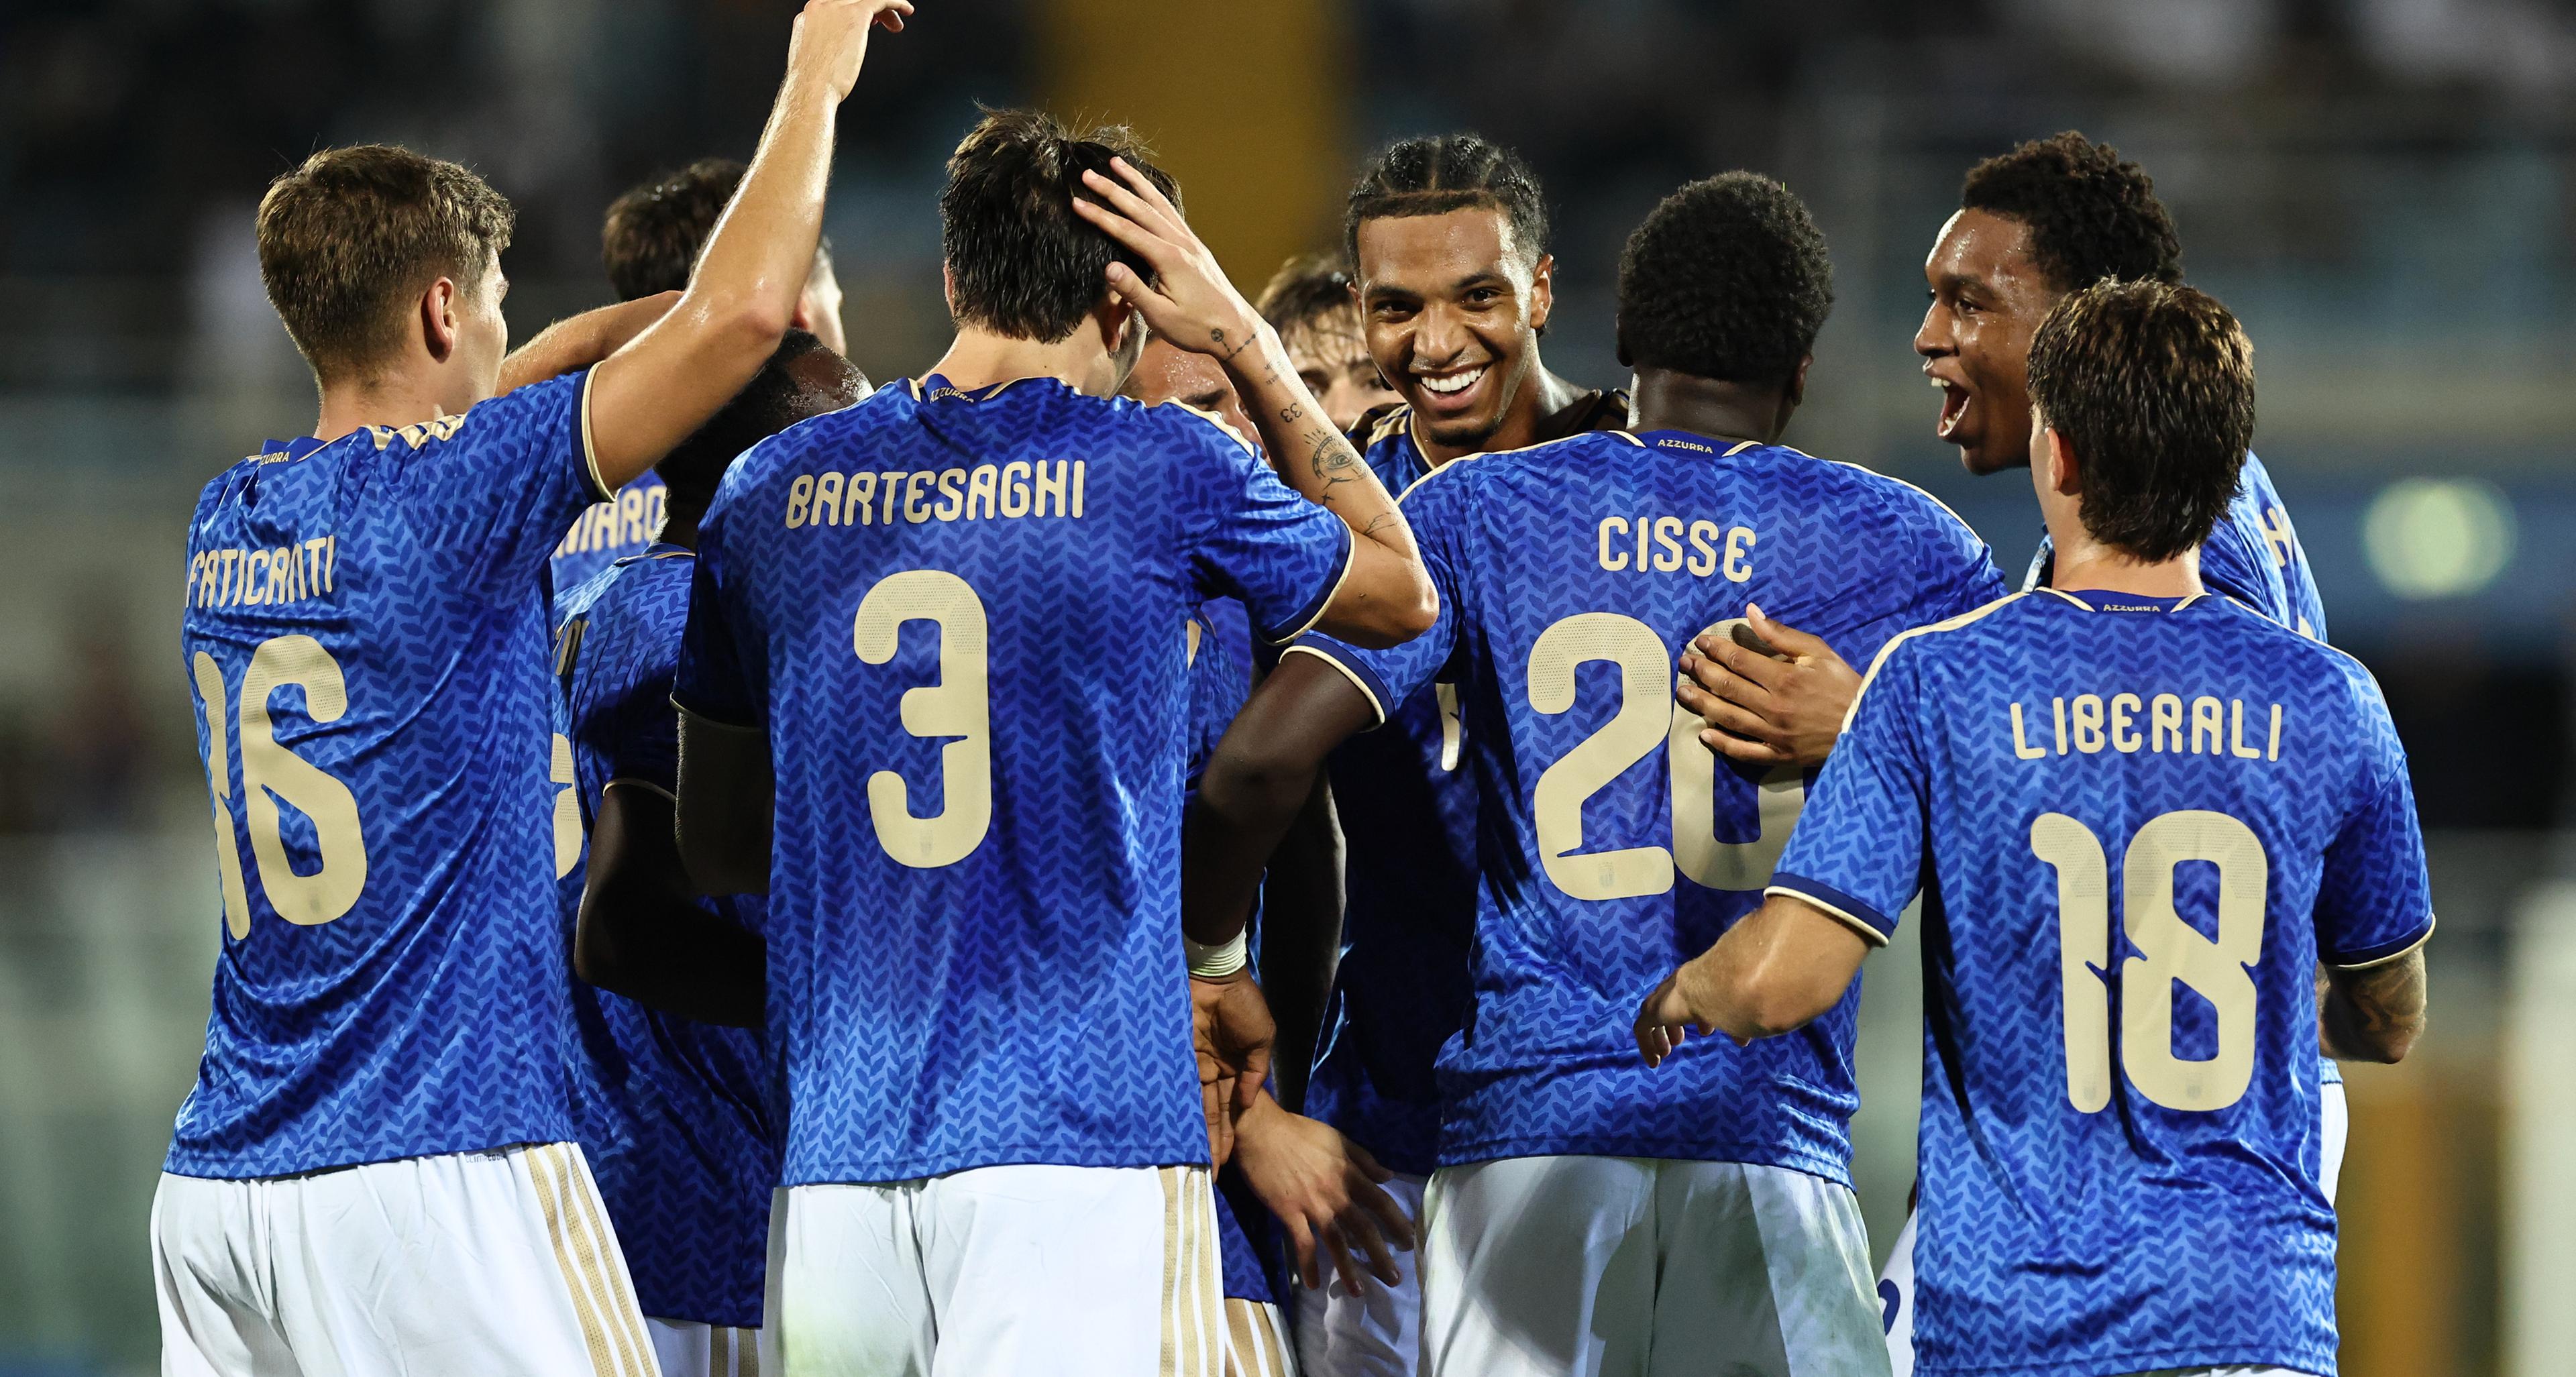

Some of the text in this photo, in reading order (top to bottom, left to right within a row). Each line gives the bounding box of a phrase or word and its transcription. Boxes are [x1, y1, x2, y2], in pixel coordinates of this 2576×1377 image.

[1658, 439, 1713, 453] AZZURRA
[786, 460, 1085, 529] BARTESAGHI
[186, 535, 335, 609] FATICANTI
[1598, 516, 1756, 582] CISSE
[2103, 604, 2161, 612] AZZURRA
[854, 569, 992, 869] 3
[2010, 693, 2282, 762] LIBERALI
[193, 635, 368, 940] 16
[2030, 810, 2269, 1114] 18
